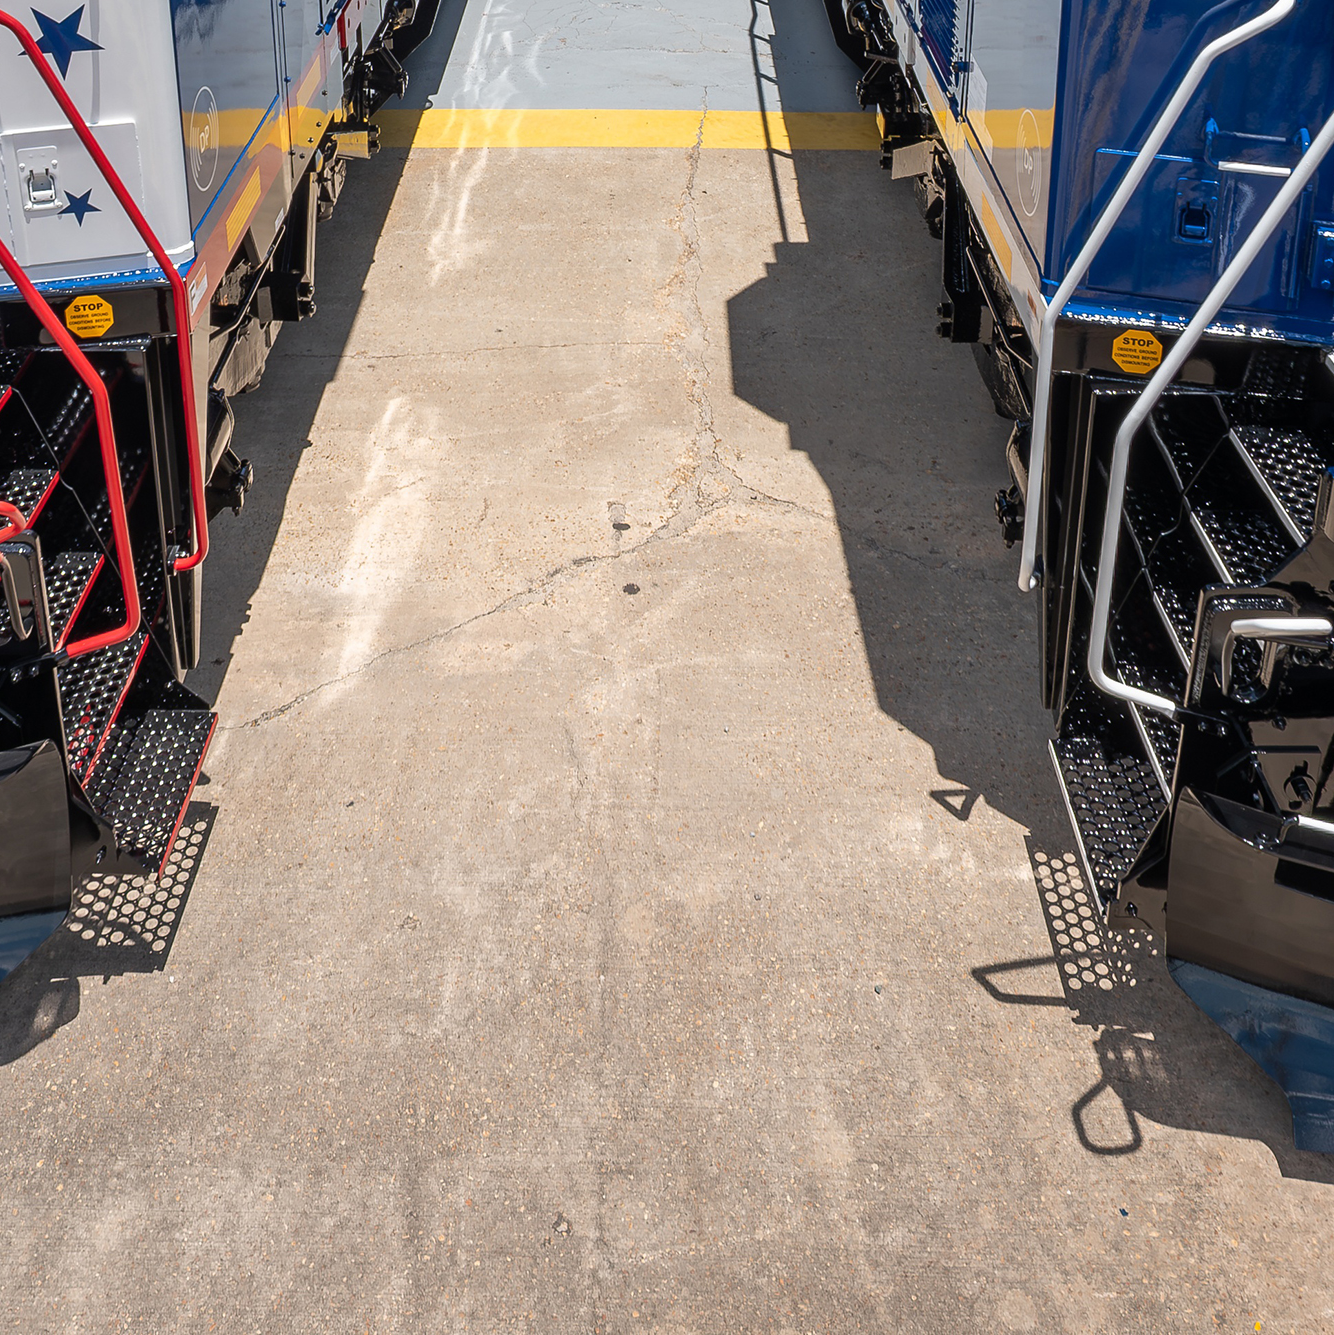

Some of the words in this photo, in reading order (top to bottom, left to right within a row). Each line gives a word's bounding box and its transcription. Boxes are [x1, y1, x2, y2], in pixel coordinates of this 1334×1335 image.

[199, 125, 210, 154] DP
[73, 303, 103, 312] STOP
[1122, 336, 1154, 347] STOP
[1117, 346, 1137, 354] OBSERVE
[1114, 352, 1140, 360] CONDITIONS
[1121, 359, 1151, 367] DISMOUNTING
